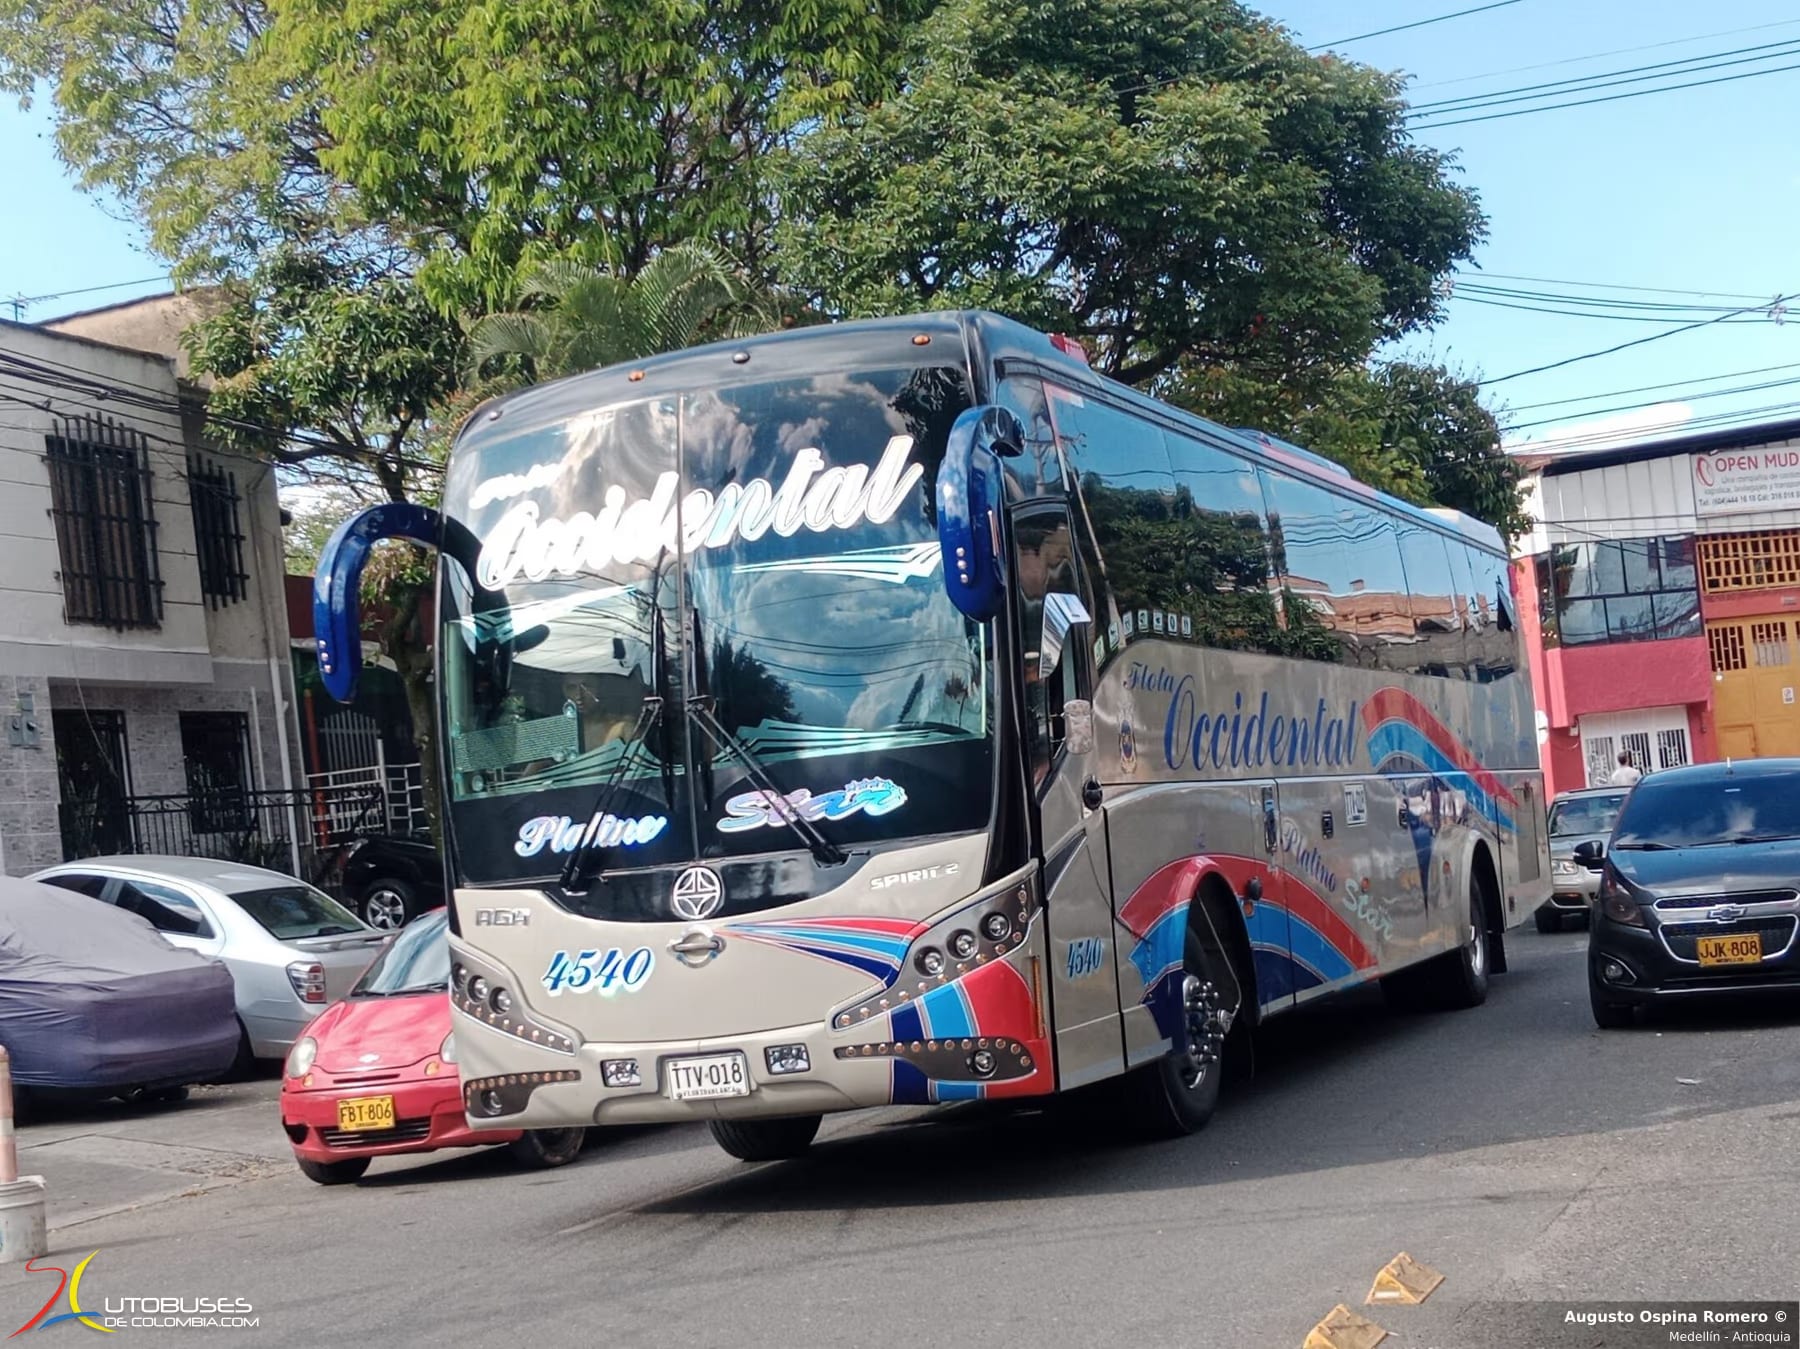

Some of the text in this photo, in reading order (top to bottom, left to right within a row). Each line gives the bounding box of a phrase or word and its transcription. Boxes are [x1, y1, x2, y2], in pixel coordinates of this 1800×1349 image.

[1715, 456, 1758, 472] OPEN
[1123, 661, 1174, 693] Flota
[1164, 674, 1361, 771] Occidental
[870, 862, 959, 890] SPIRIT 2
[1282, 818, 1337, 893] Platino
[542, 946, 655, 996] 4540
[1066, 936, 1103, 978] 4540
